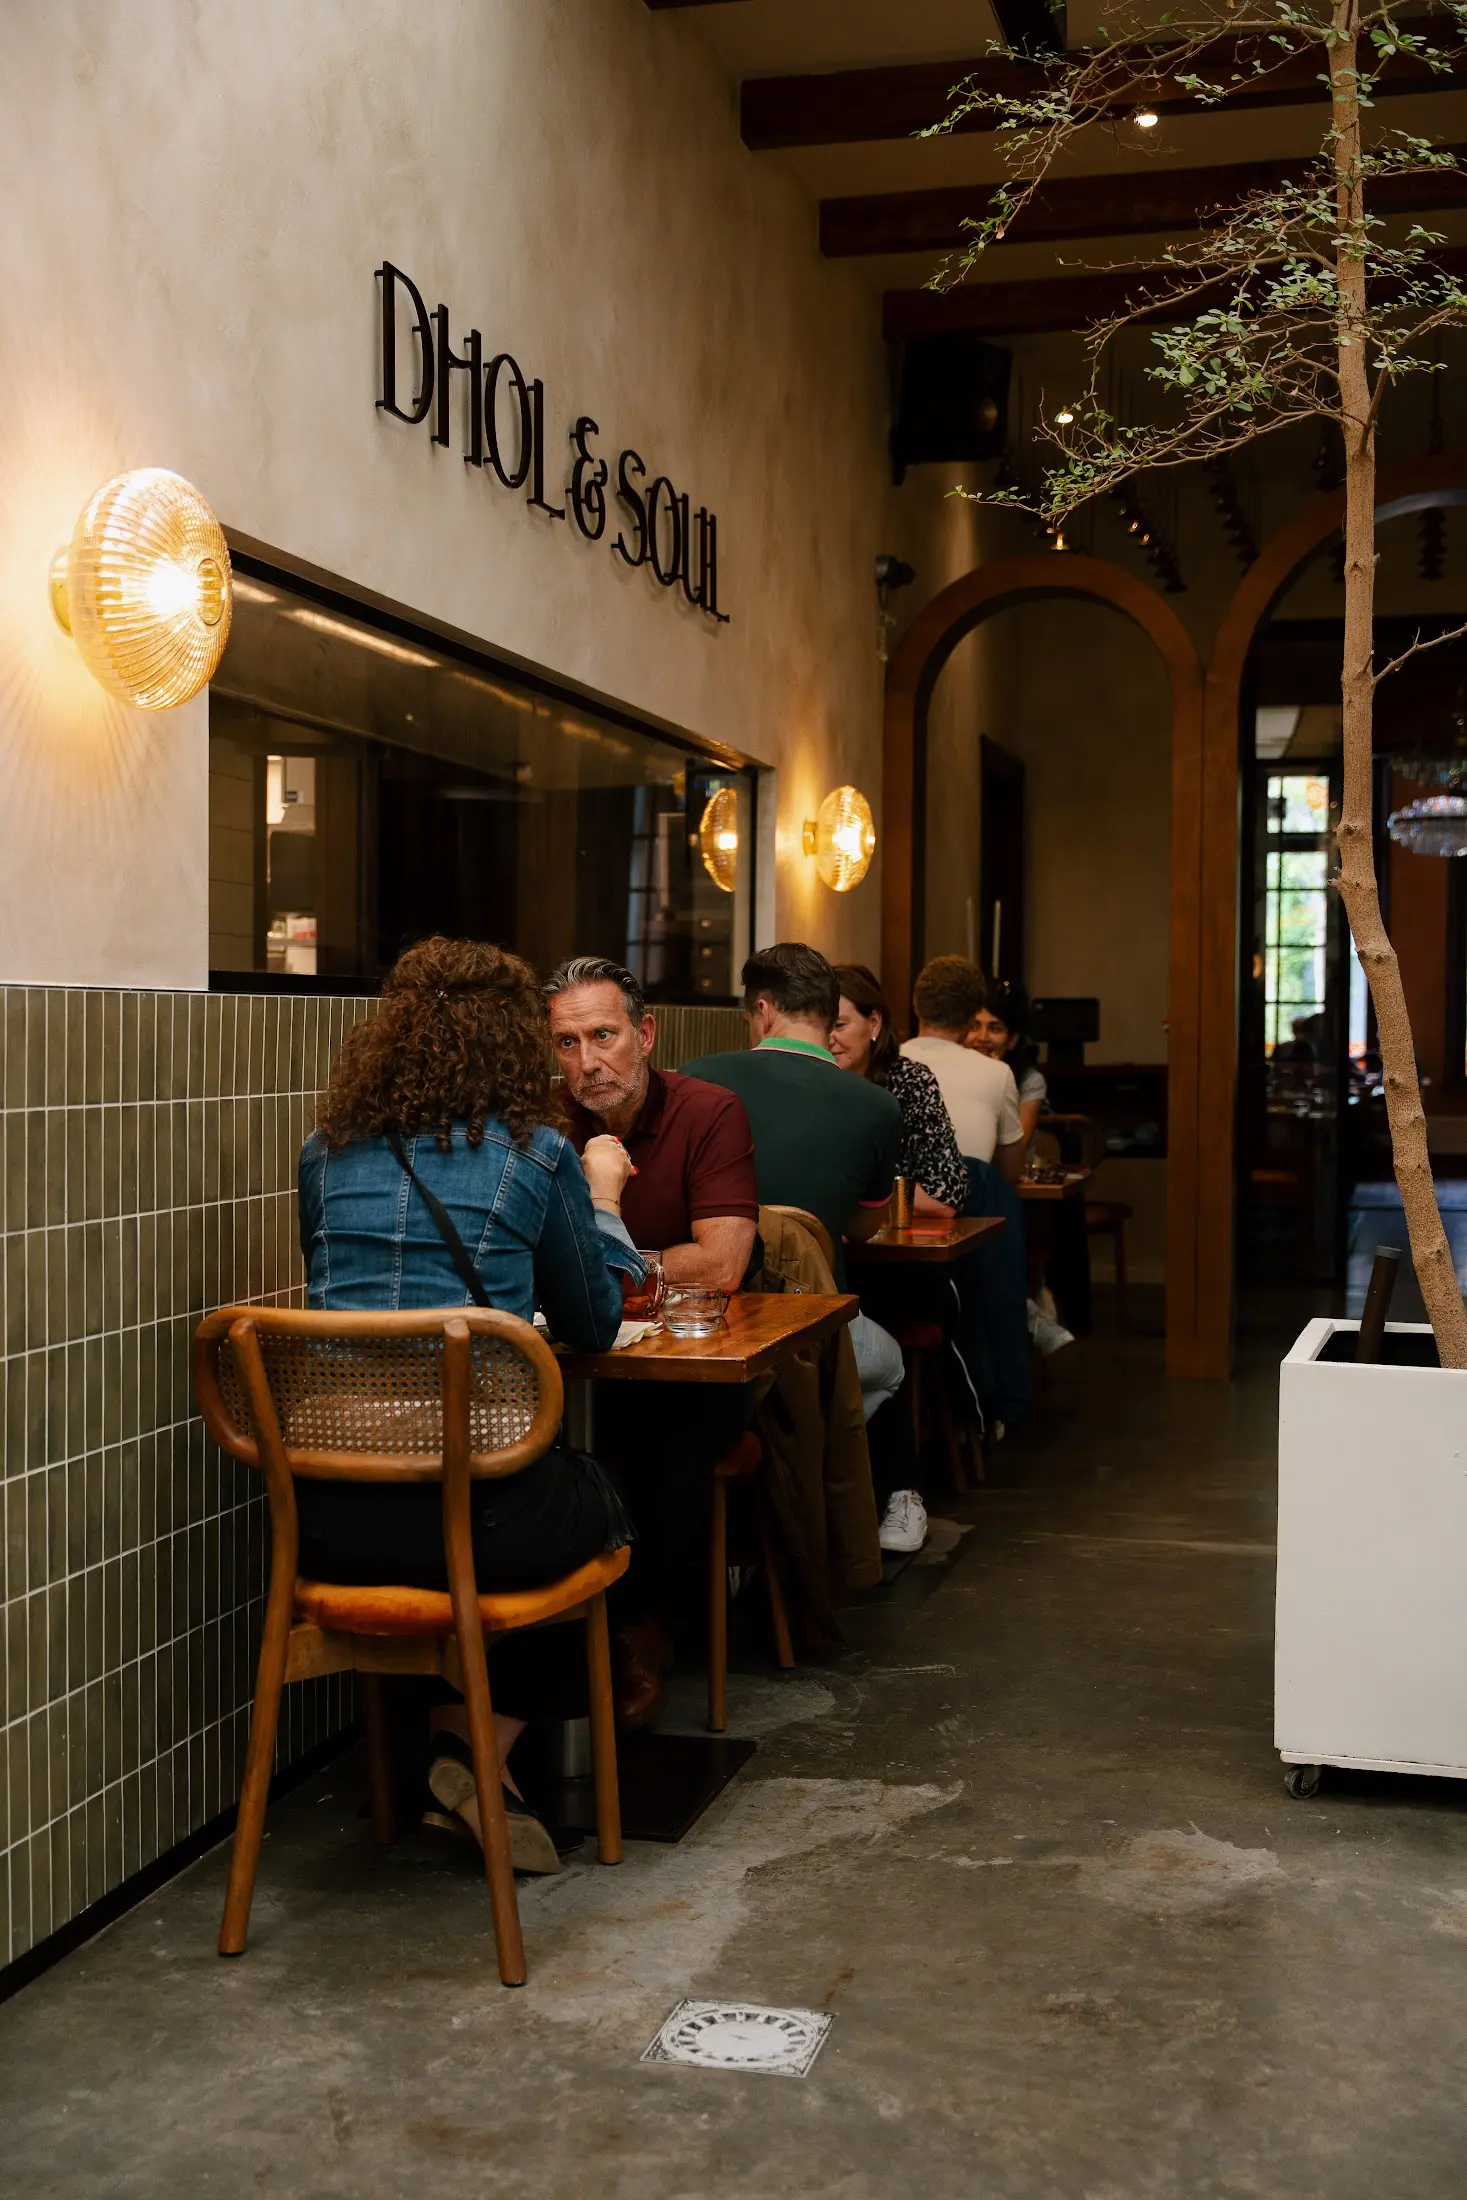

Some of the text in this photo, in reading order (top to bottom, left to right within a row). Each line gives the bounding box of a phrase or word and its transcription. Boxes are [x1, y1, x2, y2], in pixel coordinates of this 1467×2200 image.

[374, 261, 730, 623] DHOL & SOUL
